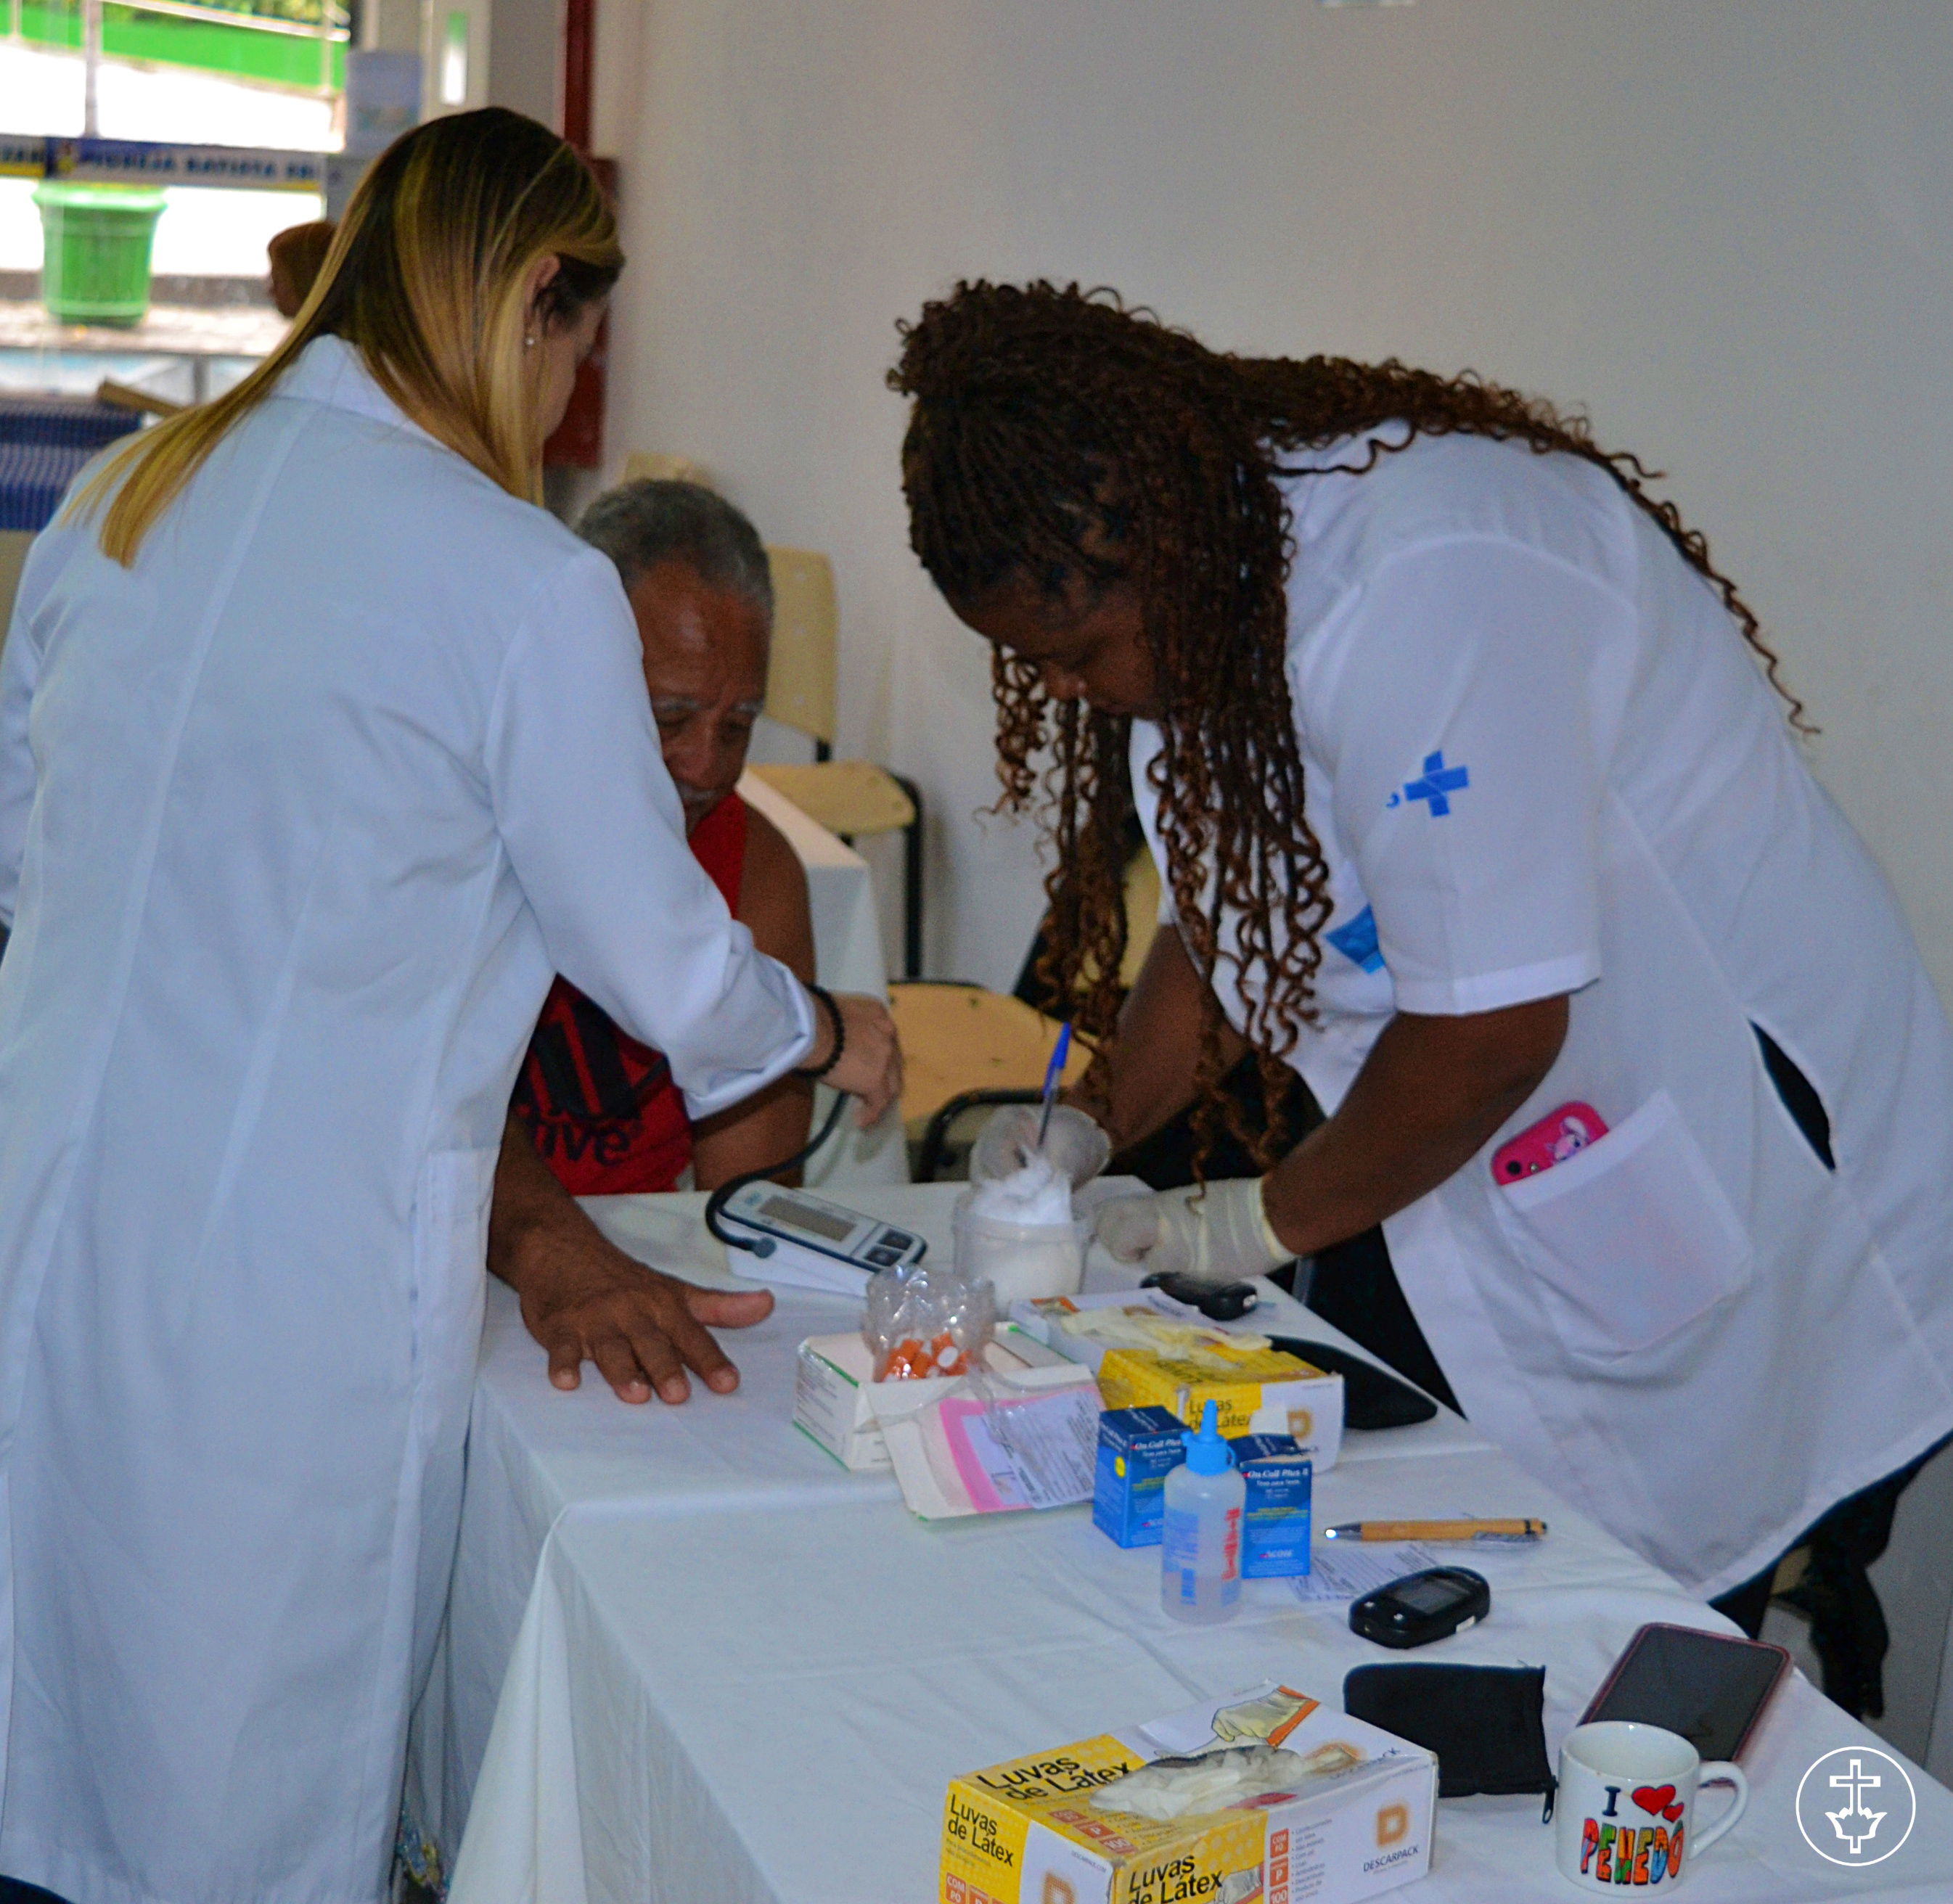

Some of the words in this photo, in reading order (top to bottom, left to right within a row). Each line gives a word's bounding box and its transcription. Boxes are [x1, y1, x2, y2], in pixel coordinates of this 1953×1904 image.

[1189, 1399, 1232, 1413] Luas
[976, 1757, 1080, 1789] Luvas
[1004, 1784, 1049, 1800] de
[1602, 1785, 1621, 1817] I
[950, 1793, 998, 1836] Luvas
[948, 1817, 967, 1840] de
[971, 1826, 1015, 1868] Látex
[1362, 1844, 1420, 1873] DESCARPACK
[1129, 1855, 1196, 1893] Luvas
[1160, 1870, 1224, 1904] Látex
